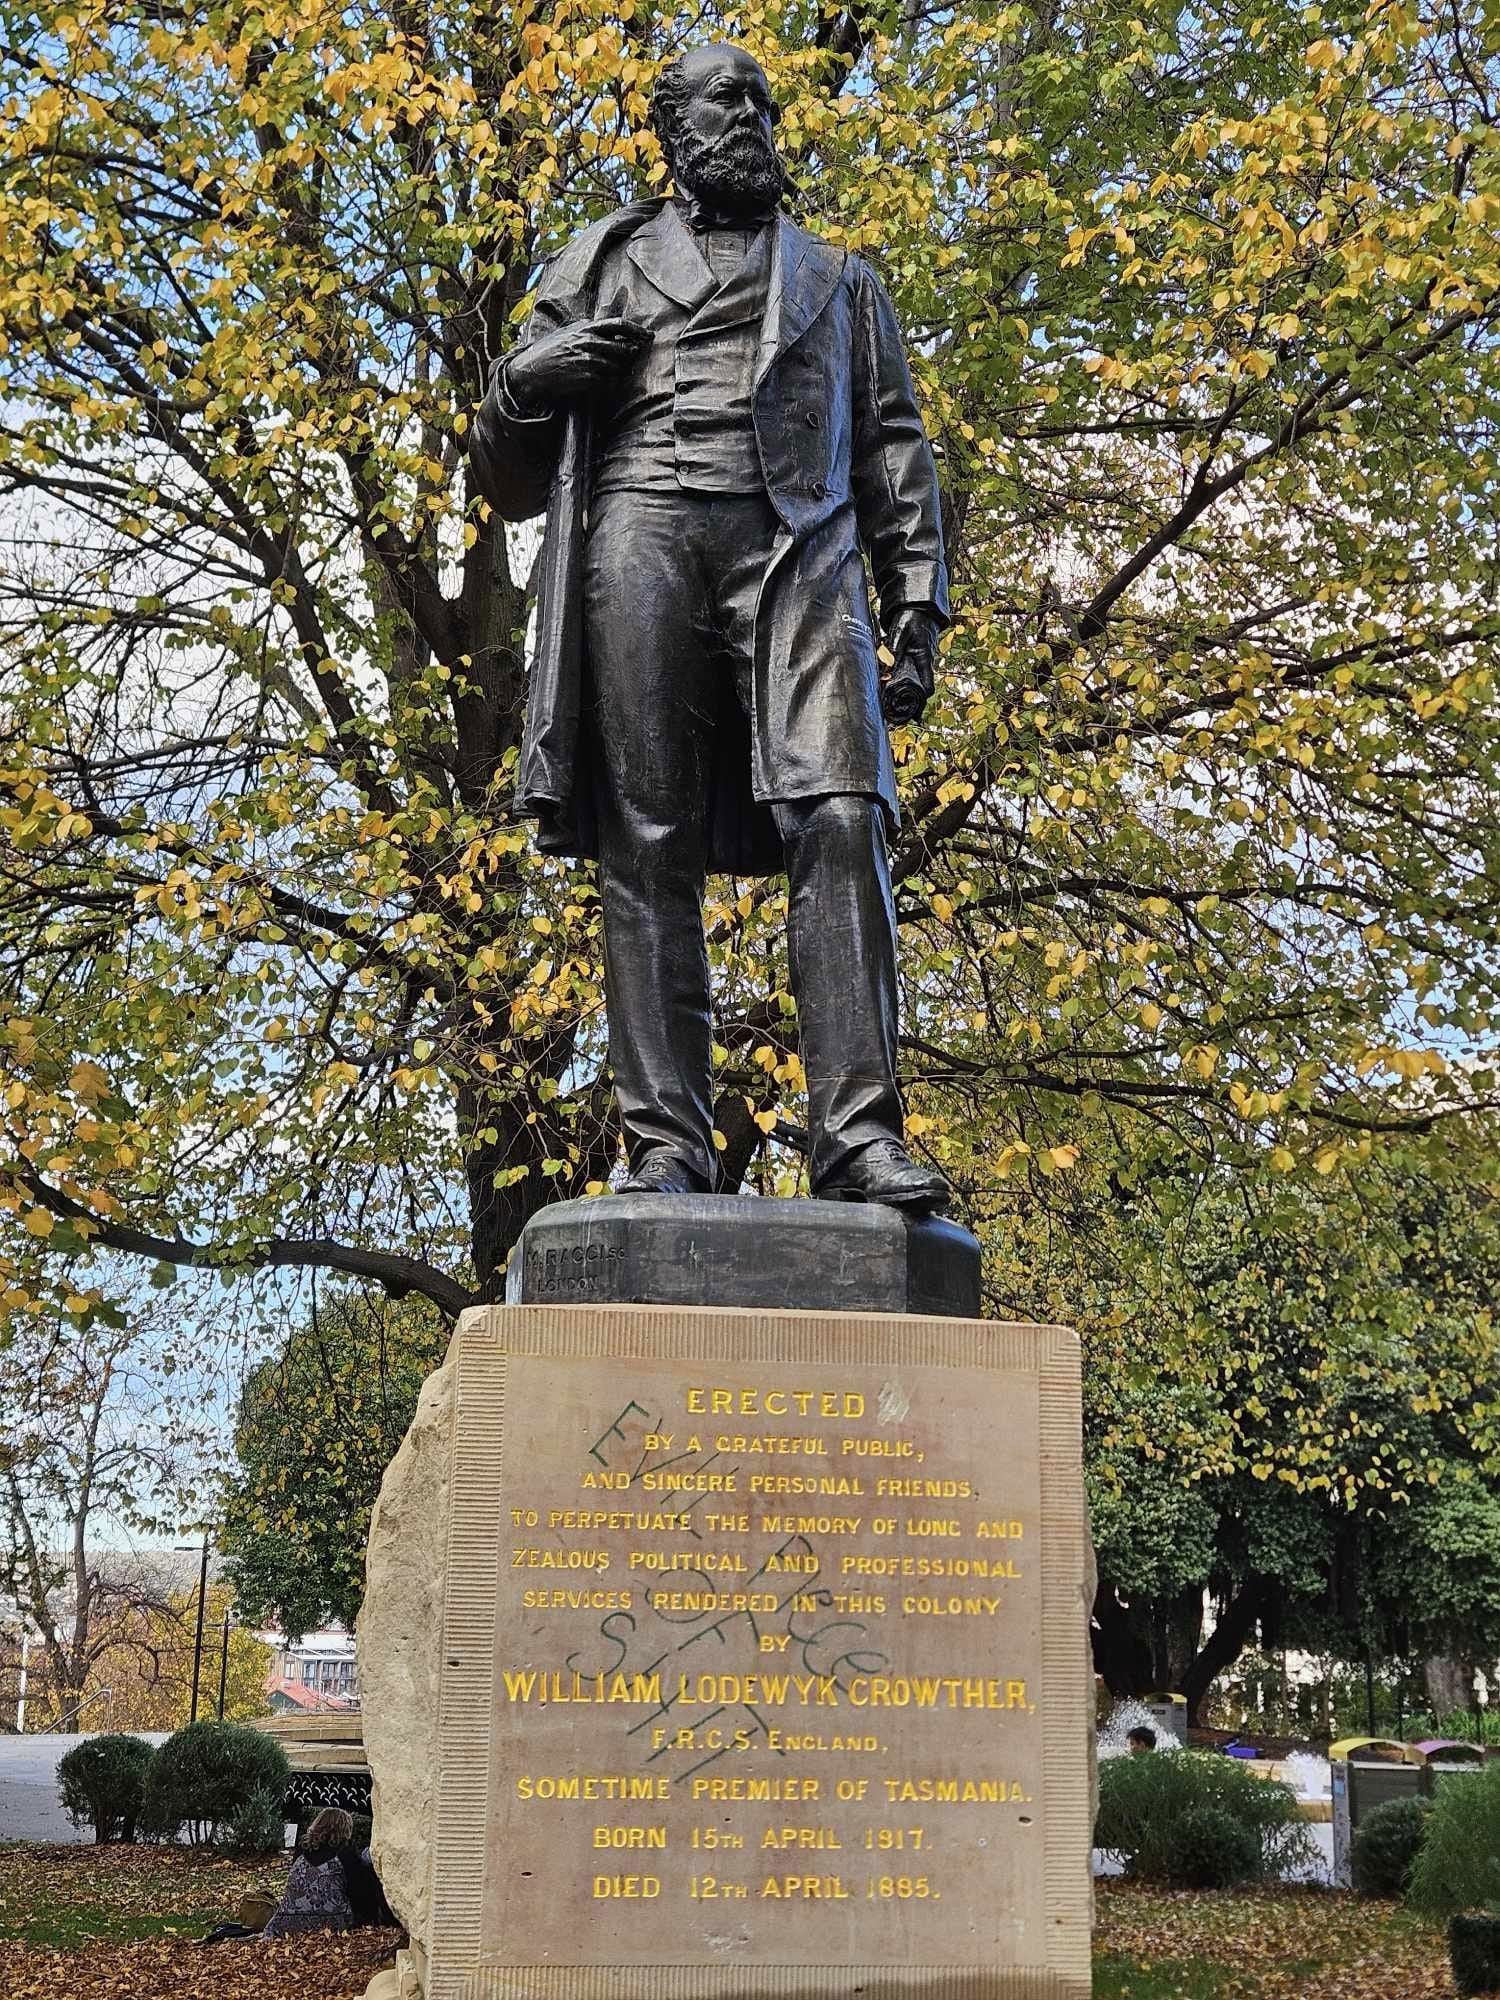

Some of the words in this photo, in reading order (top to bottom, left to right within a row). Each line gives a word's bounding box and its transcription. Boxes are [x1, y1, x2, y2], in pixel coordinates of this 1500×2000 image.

[537, 1275, 599, 1292] LONDON
[686, 1387, 866, 1418] ERECTED
[643, 1433, 675, 1452] BY
[687, 1433, 703, 1453] A
[716, 1434, 829, 1456] GRATEFUL
[842, 1437, 926, 1462] PUBLIC,
[581, 1471, 630, 1491] AND
[642, 1473, 737, 1492] SINCERE
[750, 1476, 865, 1495] PERSONAL
[510, 1509, 539, 1529] TO
[549, 1510, 693, 1531] PERPETUATE
[705, 1513, 750, 1532] THE
[761, 1516, 861, 1535] MEMORY
[872, 1518, 898, 1537] OF
[976, 1520, 1024, 1540] AND
[511, 1549, 610, 1570] ZEALOUS
[630, 1551, 747, 1573] POLITICAL
[765, 1554, 820, 1574] AND
[841, 1557, 1023, 1579] PROFESSIONAL
[522, 1590, 632, 1609] SERVICES
[653, 1592, 778, 1613] RENDERED
[791, 1594, 817, 1614] IN
[833, 1595, 887, 1615] THIS
[903, 1597, 1001, 1616] COLONY
[759, 1634, 792, 1653] BY
[503, 1671, 662, 1704] WILLIAM
[678, 1673, 839, 1707] LODEWYK
[516, 1776, 670, 1799] SOMETIME
[692, 1778, 820, 1800] PREMIER
[836, 1779, 869, 1801] OF
[591, 1827, 667, 1849] BORN
[760, 1828, 842, 1850] APRIL
[592, 1876, 661, 1898] DIED
[760, 1877, 849, 1899] APRIL
[865, 1877, 941, 1900] 1885.
